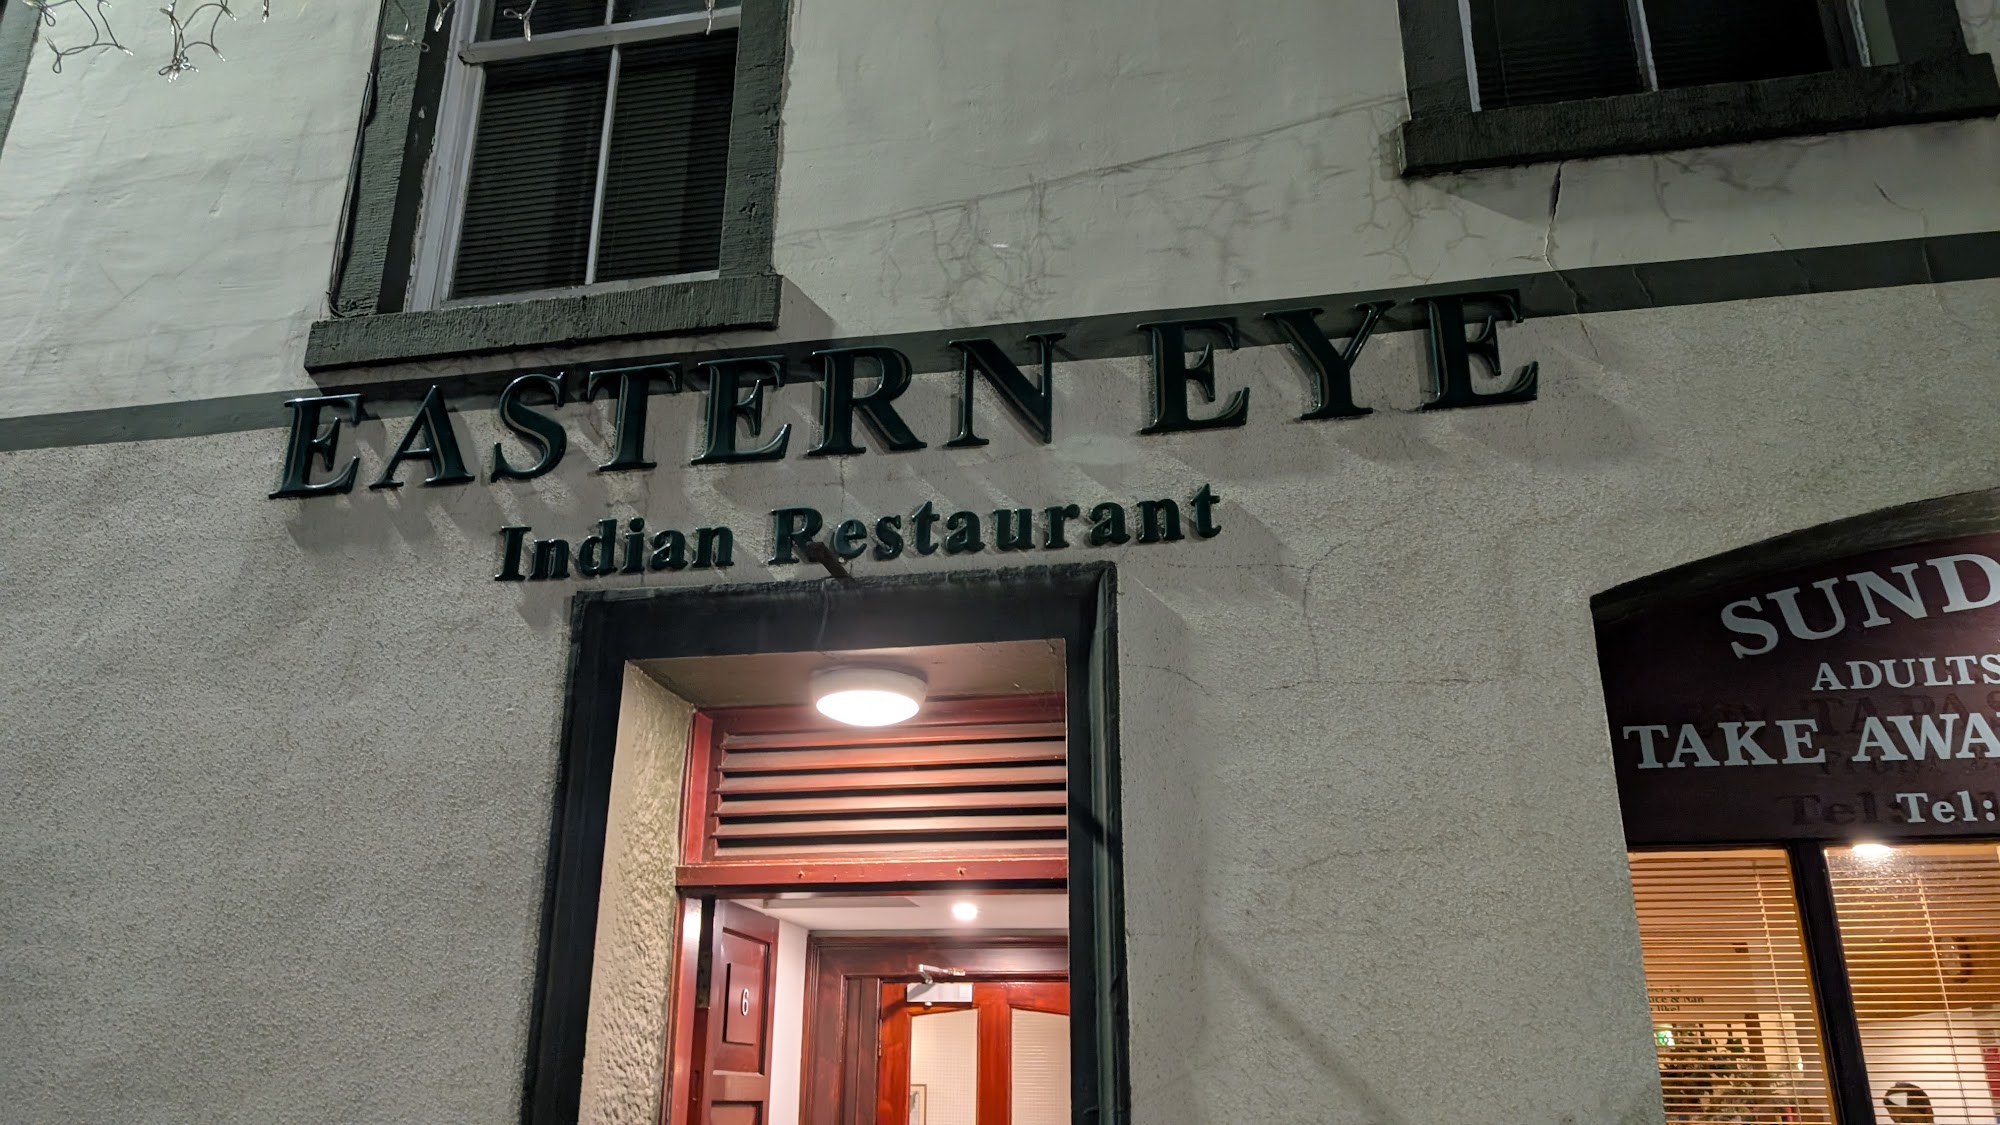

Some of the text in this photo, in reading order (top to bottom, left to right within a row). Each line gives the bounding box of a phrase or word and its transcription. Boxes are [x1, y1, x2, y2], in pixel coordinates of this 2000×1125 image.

[269, 289, 1538, 499] EASTERN EYE
[495, 483, 1220, 582] Indian Restaurant
[1812, 653, 2000, 691] ADULTS
[1623, 718, 1826, 769] TAKE
[1852, 711, 2000, 763] AWA
[1896, 790, 1996, 823] Tel:
[741, 988, 749, 1016] 6
